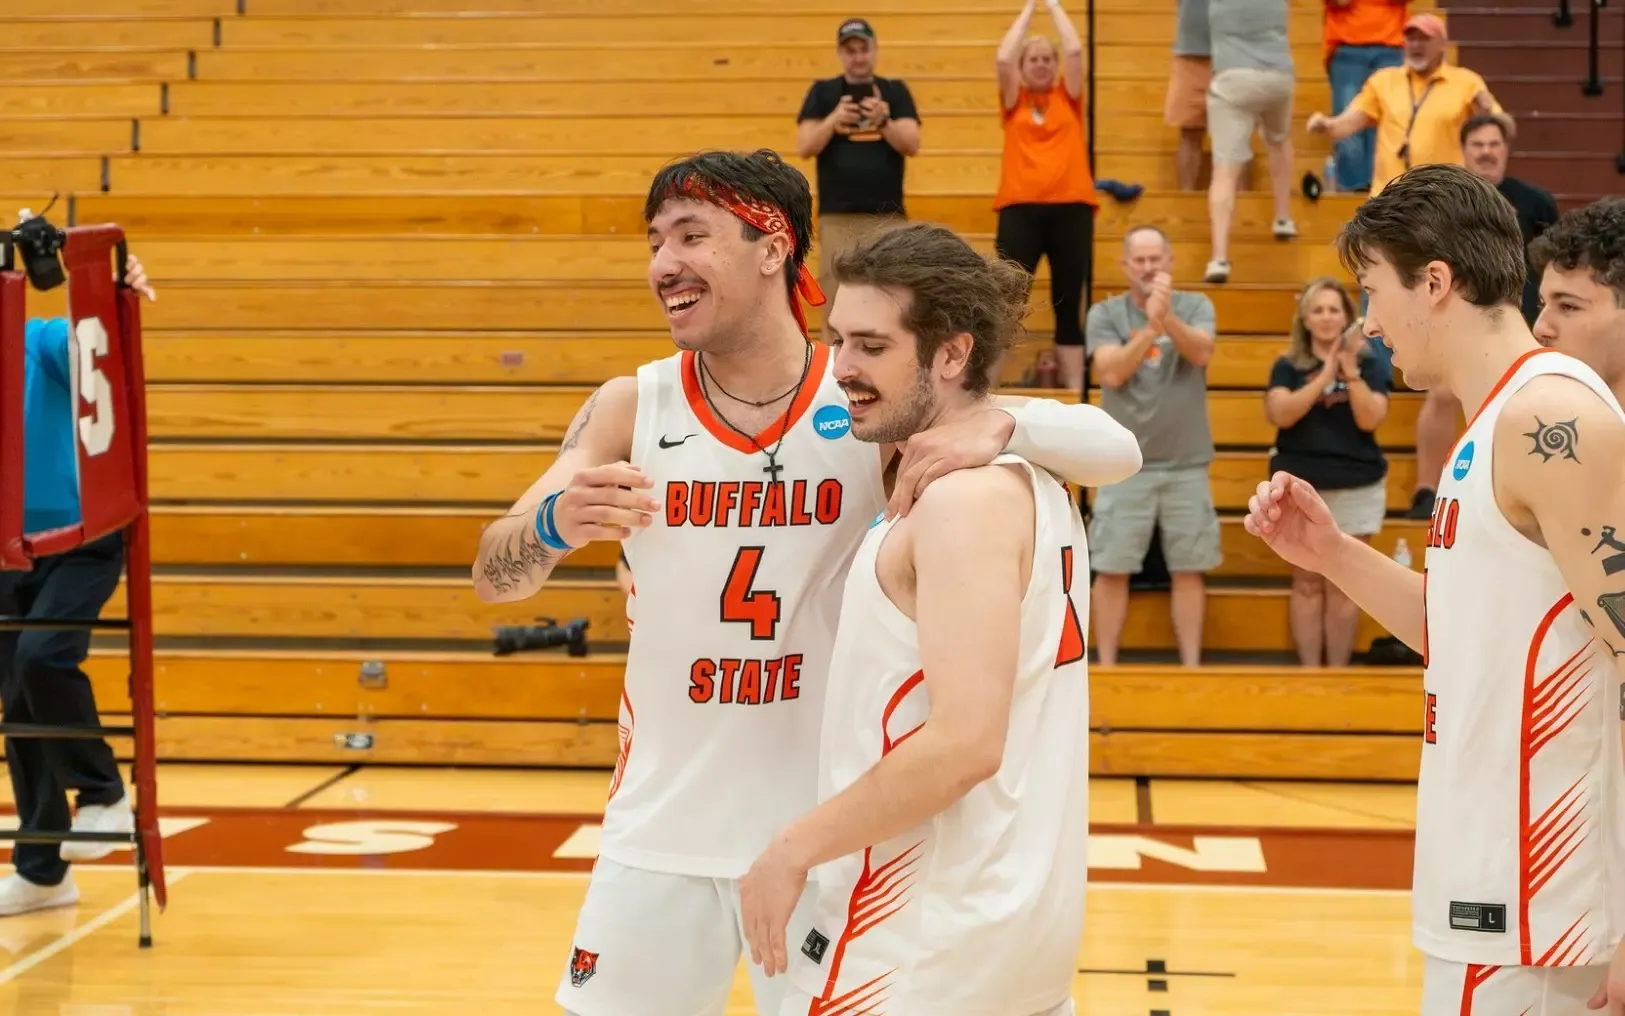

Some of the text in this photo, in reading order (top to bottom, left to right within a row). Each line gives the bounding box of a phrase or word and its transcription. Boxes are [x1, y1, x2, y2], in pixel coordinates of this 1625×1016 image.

[76, 316, 115, 457] S
[819, 418, 849, 431] NCAA
[666, 478, 843, 527] BUFFALO
[720, 545, 781, 640] 4
[689, 653, 803, 705] STATE
